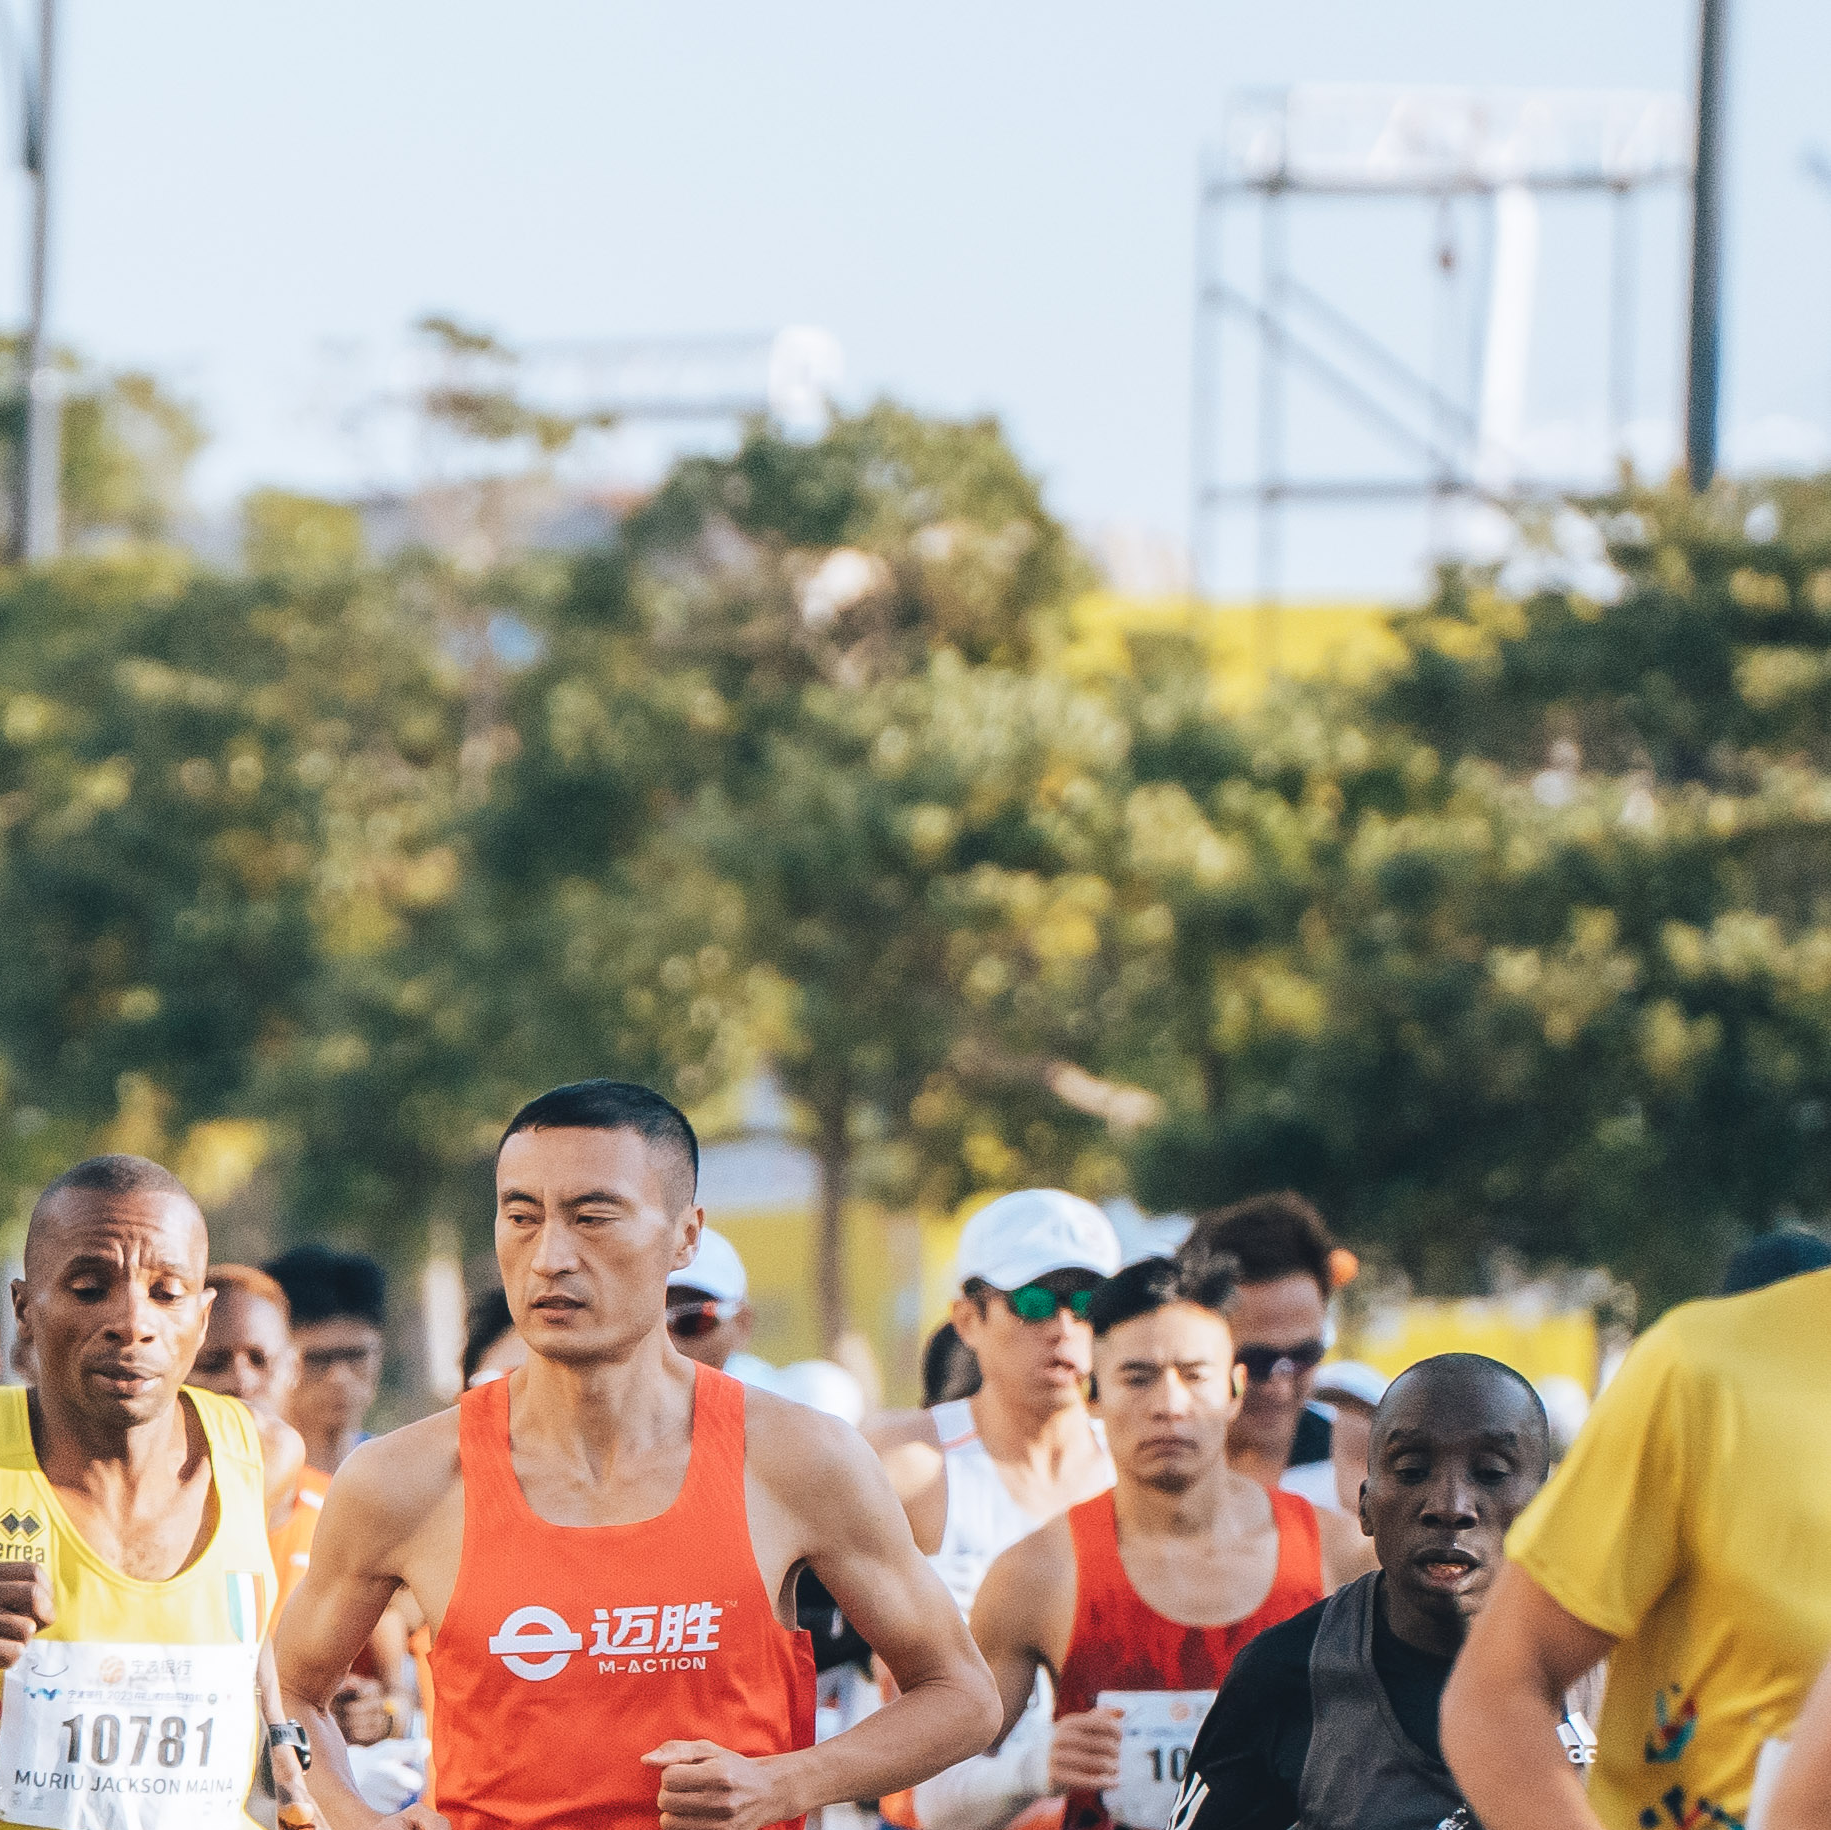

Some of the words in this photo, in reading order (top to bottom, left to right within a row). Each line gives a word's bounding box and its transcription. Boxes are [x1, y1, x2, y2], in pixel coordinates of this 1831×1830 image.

[588, 1601, 723, 1656] 迈胜
[598, 1656, 706, 1674] M-ACTION
[61, 1713, 214, 1767] 10781
[14, 1769, 84, 1791] MURIU
[90, 1776, 181, 1794] JACKSON
[185, 1777, 233, 1793] MAINA
